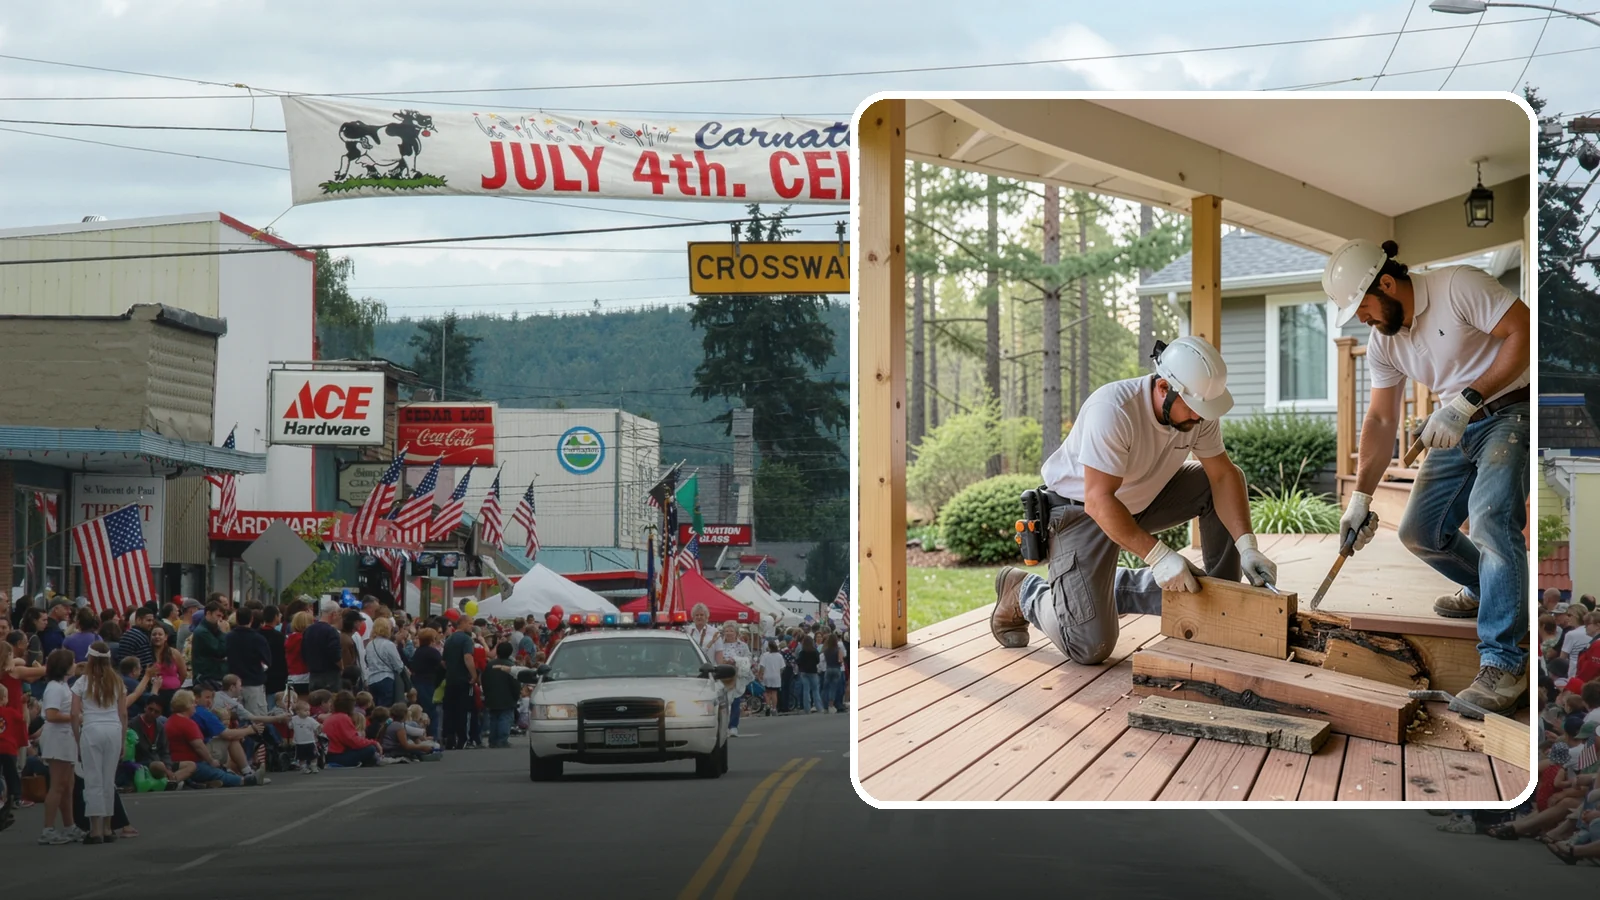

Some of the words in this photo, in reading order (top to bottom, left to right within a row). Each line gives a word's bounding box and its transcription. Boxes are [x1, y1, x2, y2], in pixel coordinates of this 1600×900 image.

[695, 121, 850, 150] Carnat
[481, 141, 605, 193] JULY
[632, 150, 746, 198] 4th.
[697, 253, 850, 280] CROSSWA
[283, 380, 373, 420] ACE
[406, 409, 453, 422] CEDAR
[283, 421, 371, 436] Hardware
[416, 428, 477, 447] Coca-Cola
[83, 485, 93, 494] St.
[96, 485, 124, 495] Vincent
[126, 485, 135, 495] de
[137, 486, 155, 495] Paul
[213, 516, 331, 536] HARDARE
[688, 526, 742, 535] CRNATION
[698, 535, 730, 543] GLASS
